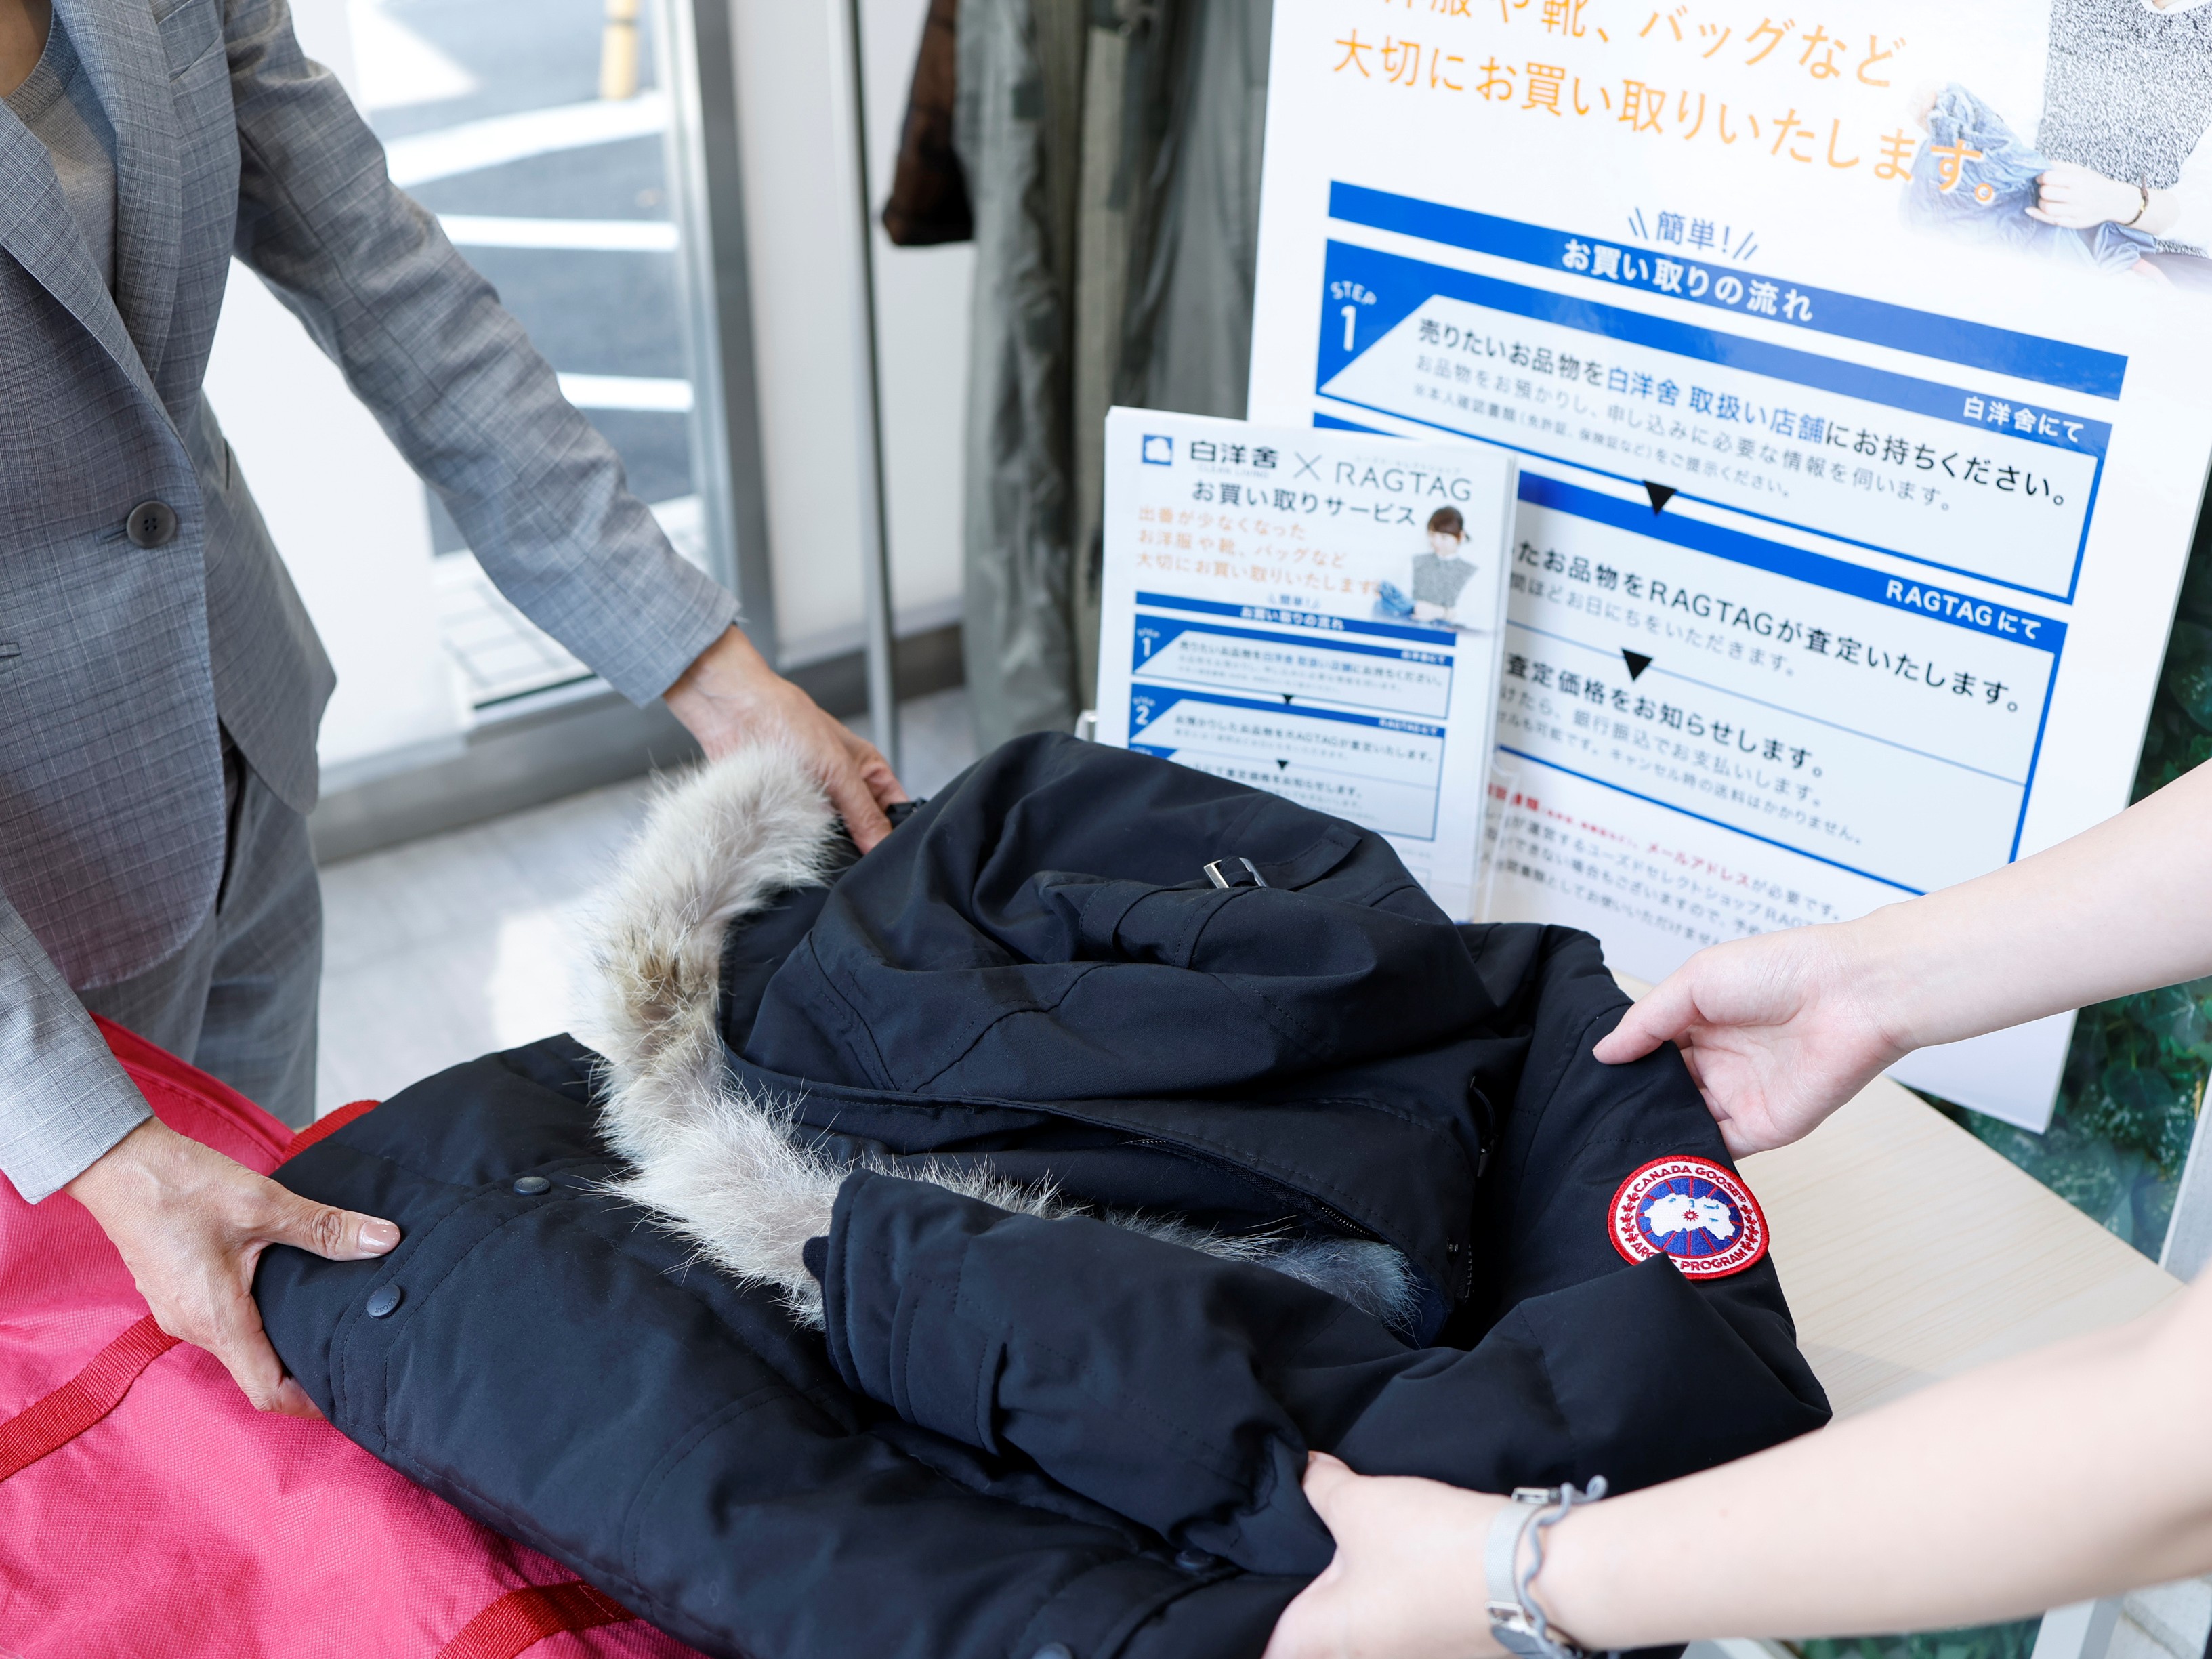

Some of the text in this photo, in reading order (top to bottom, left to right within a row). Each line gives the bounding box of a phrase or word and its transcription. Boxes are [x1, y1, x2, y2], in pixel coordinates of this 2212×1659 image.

[1333, 28, 1994, 203] 大切にお買い取りいたします。
[1329, 280, 1377, 306] STEP
[1562, 238, 1813, 322] お買い取りの流れ
[1341, 305, 1357, 352] 1
[1335, 461, 1472, 501] RAGTAG
[1191, 480, 1417, 526] お買い取りサービス
[1142, 637, 1152, 658] 1
[1135, 705, 1150, 726] 2
[1633, 1165, 1692, 1192] CANADA
[1680, 1248, 1747, 1271] PROGRAM
